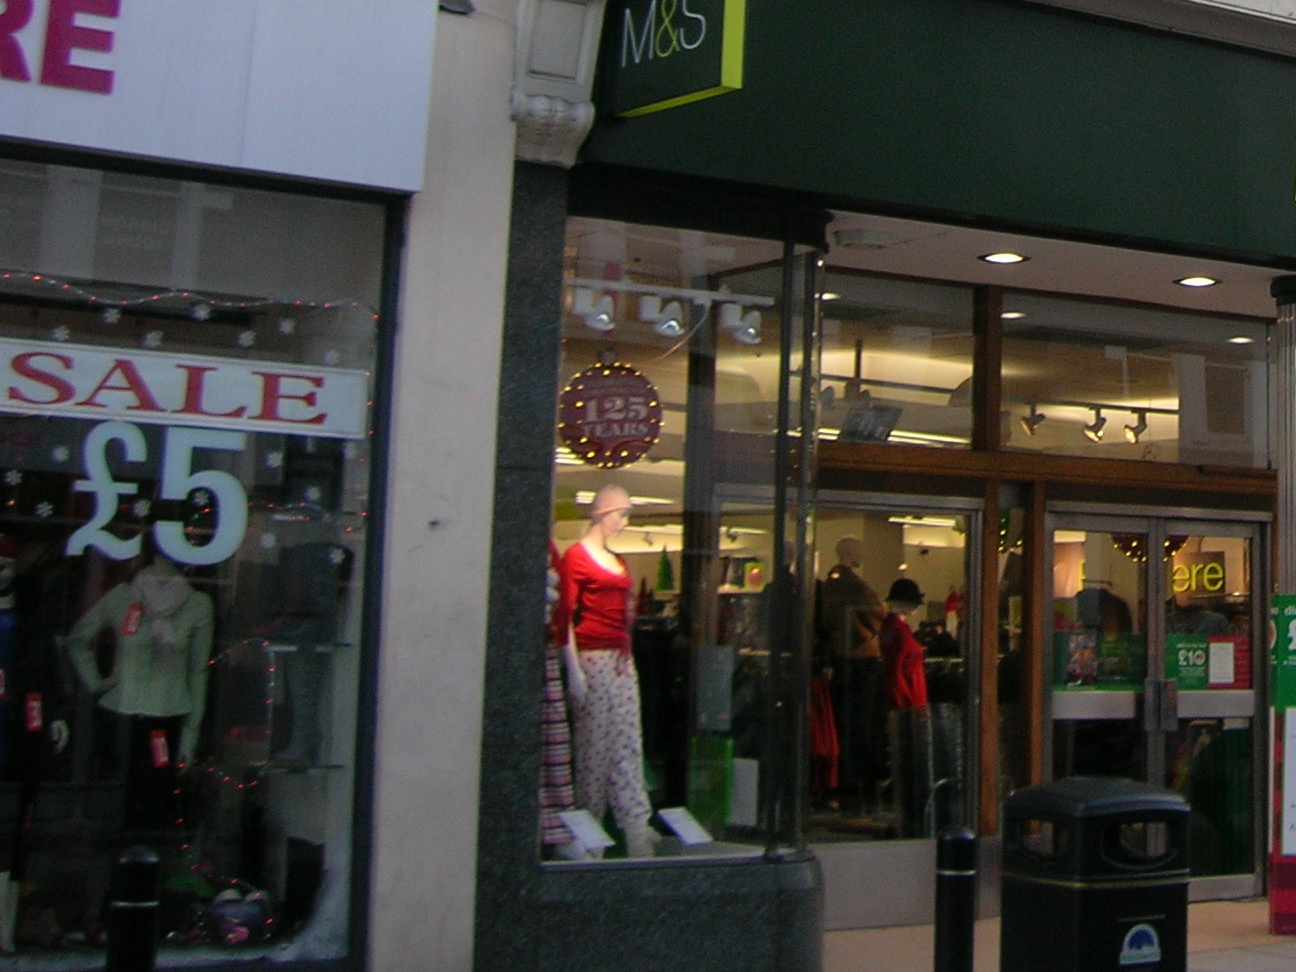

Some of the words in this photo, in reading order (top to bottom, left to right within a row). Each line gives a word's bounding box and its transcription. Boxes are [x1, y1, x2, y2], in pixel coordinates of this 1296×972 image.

[7, 351, 329, 425] SALE
[586, 395, 649, 422] 125
[65, 420, 249, 566] £5
[1178, 649, 1206, 665] £10
